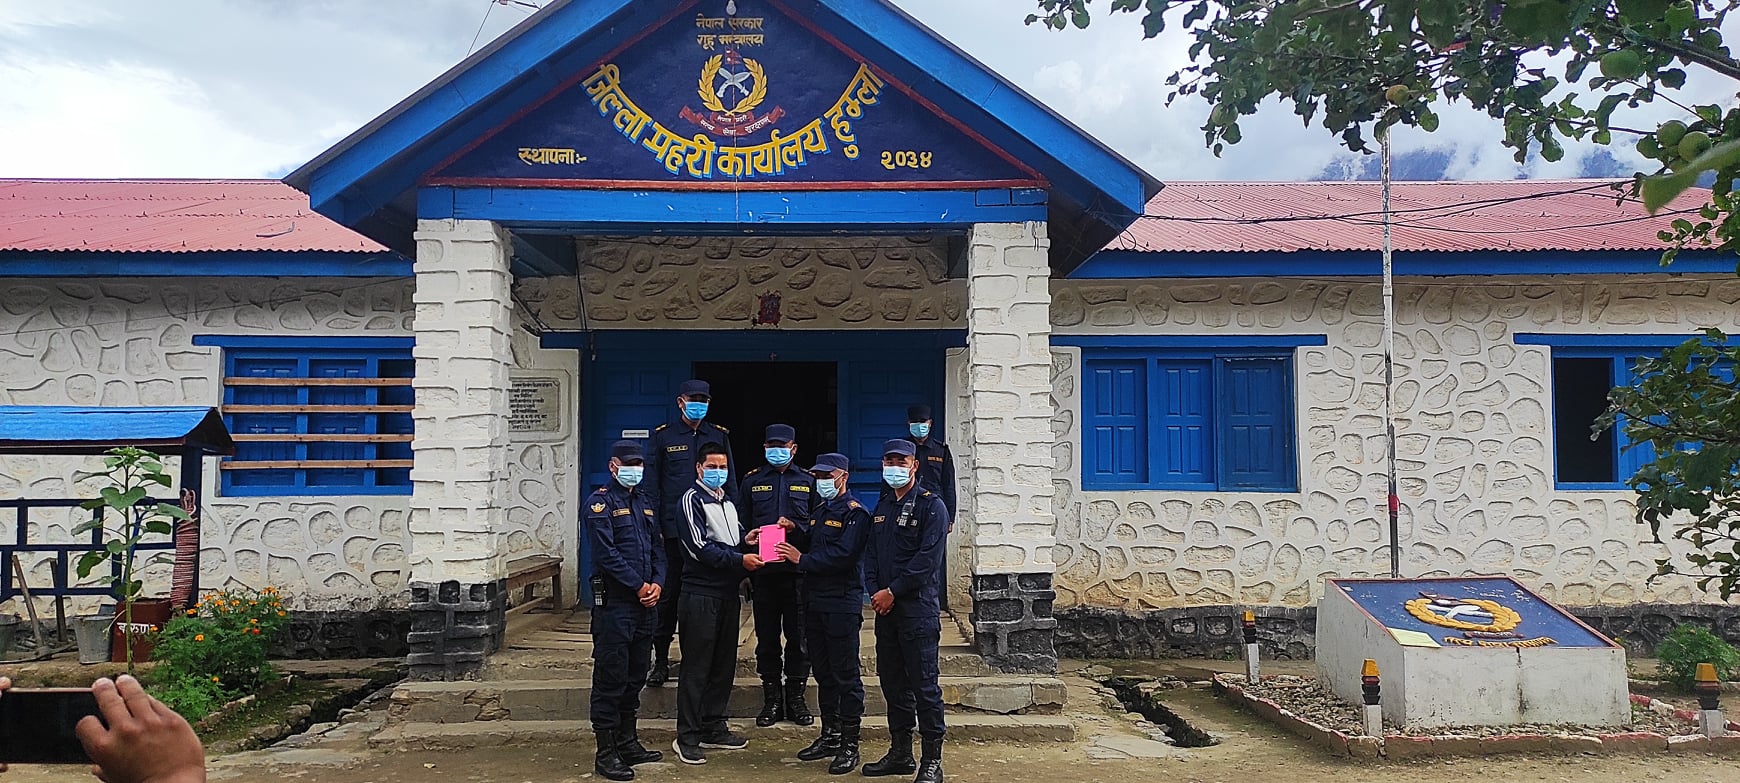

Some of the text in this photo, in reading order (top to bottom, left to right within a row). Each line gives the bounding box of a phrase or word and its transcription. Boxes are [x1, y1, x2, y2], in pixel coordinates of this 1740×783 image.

[696, 13, 764, 31] नेपाल सरकार
[697, 34, 717, 50] गृह
[581, 62, 885, 178] जिल्ला प्रहरी कार्यालय हुम्ला
[880, 150, 933, 170] २०३४
